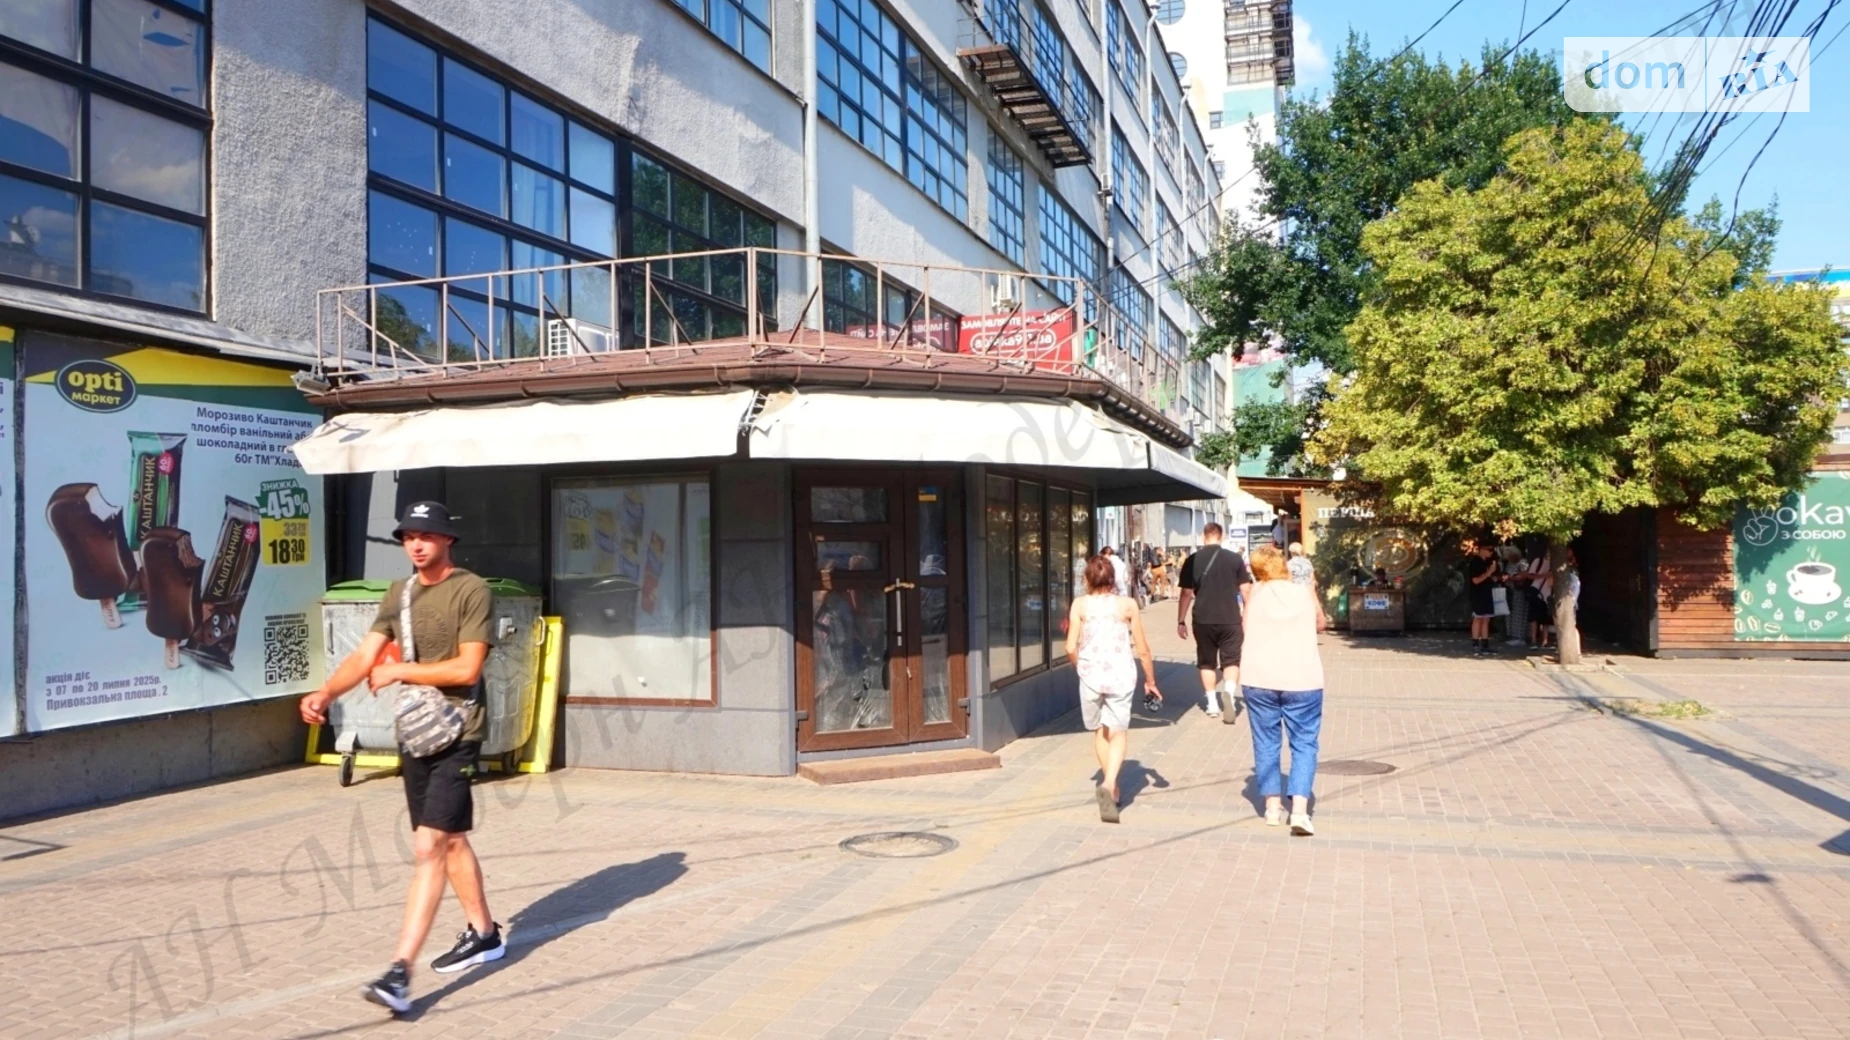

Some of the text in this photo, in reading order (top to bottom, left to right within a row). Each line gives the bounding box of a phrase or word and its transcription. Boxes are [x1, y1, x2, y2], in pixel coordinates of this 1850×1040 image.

[68, 371, 124, 393] opti
[71, 392, 122, 405] маркет
[196, 406, 313, 428] Морозиво Каштанчик
[191, 422, 308, 441] пломбір ванільний аб
[196, 438, 267, 452] шоколадний
[234, 454, 252, 464] 60г
[262, 480, 298, 492] ЗНИЖКА
[259, 489, 310, 520] -45%
[1776, 495, 1850, 526] oka
[1792, 529, 1846, 540] СОБОЮ
[213, 523, 244, 597] КАШТАНЧИК
[268, 539, 305, 564] 18 30
[46, 670, 90, 684] акція діє
[56, 685, 66, 696] 07
[72, 684, 84, 694] по
[88, 682, 99, 692] 20
[102, 679, 130, 690] липня
[46, 692, 122, 711] Привокзальна
